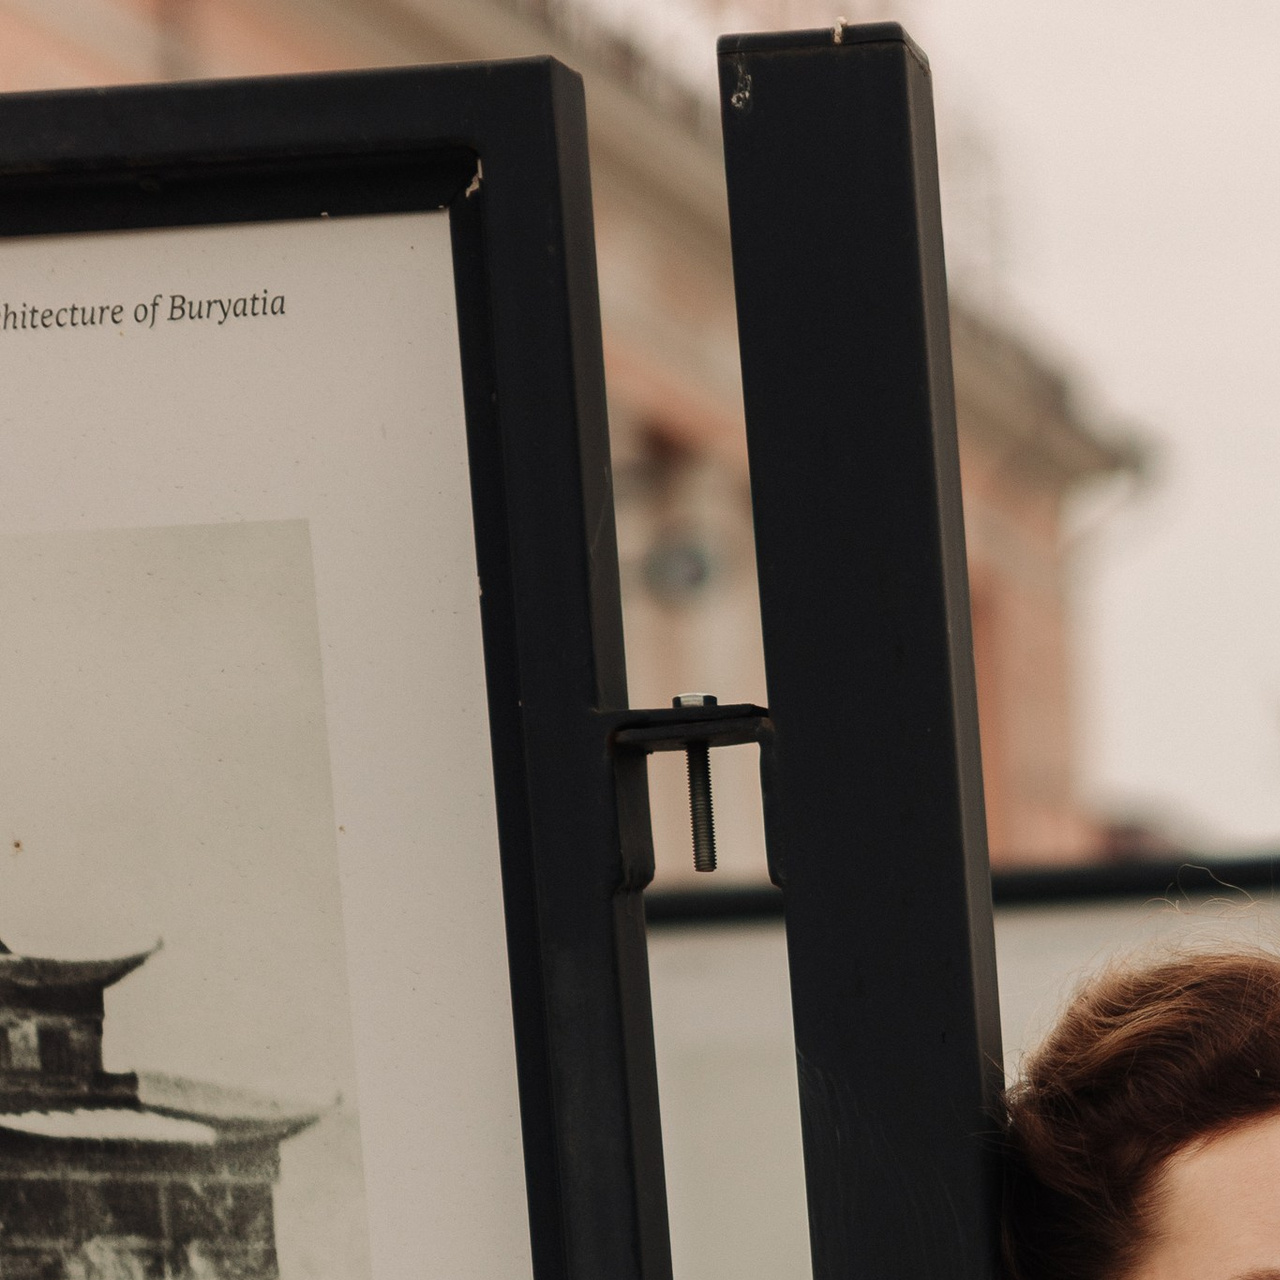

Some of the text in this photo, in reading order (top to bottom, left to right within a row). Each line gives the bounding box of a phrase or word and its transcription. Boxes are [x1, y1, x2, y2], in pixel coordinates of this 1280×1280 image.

[0, 288, 286, 331] hitecture of Buryatia
